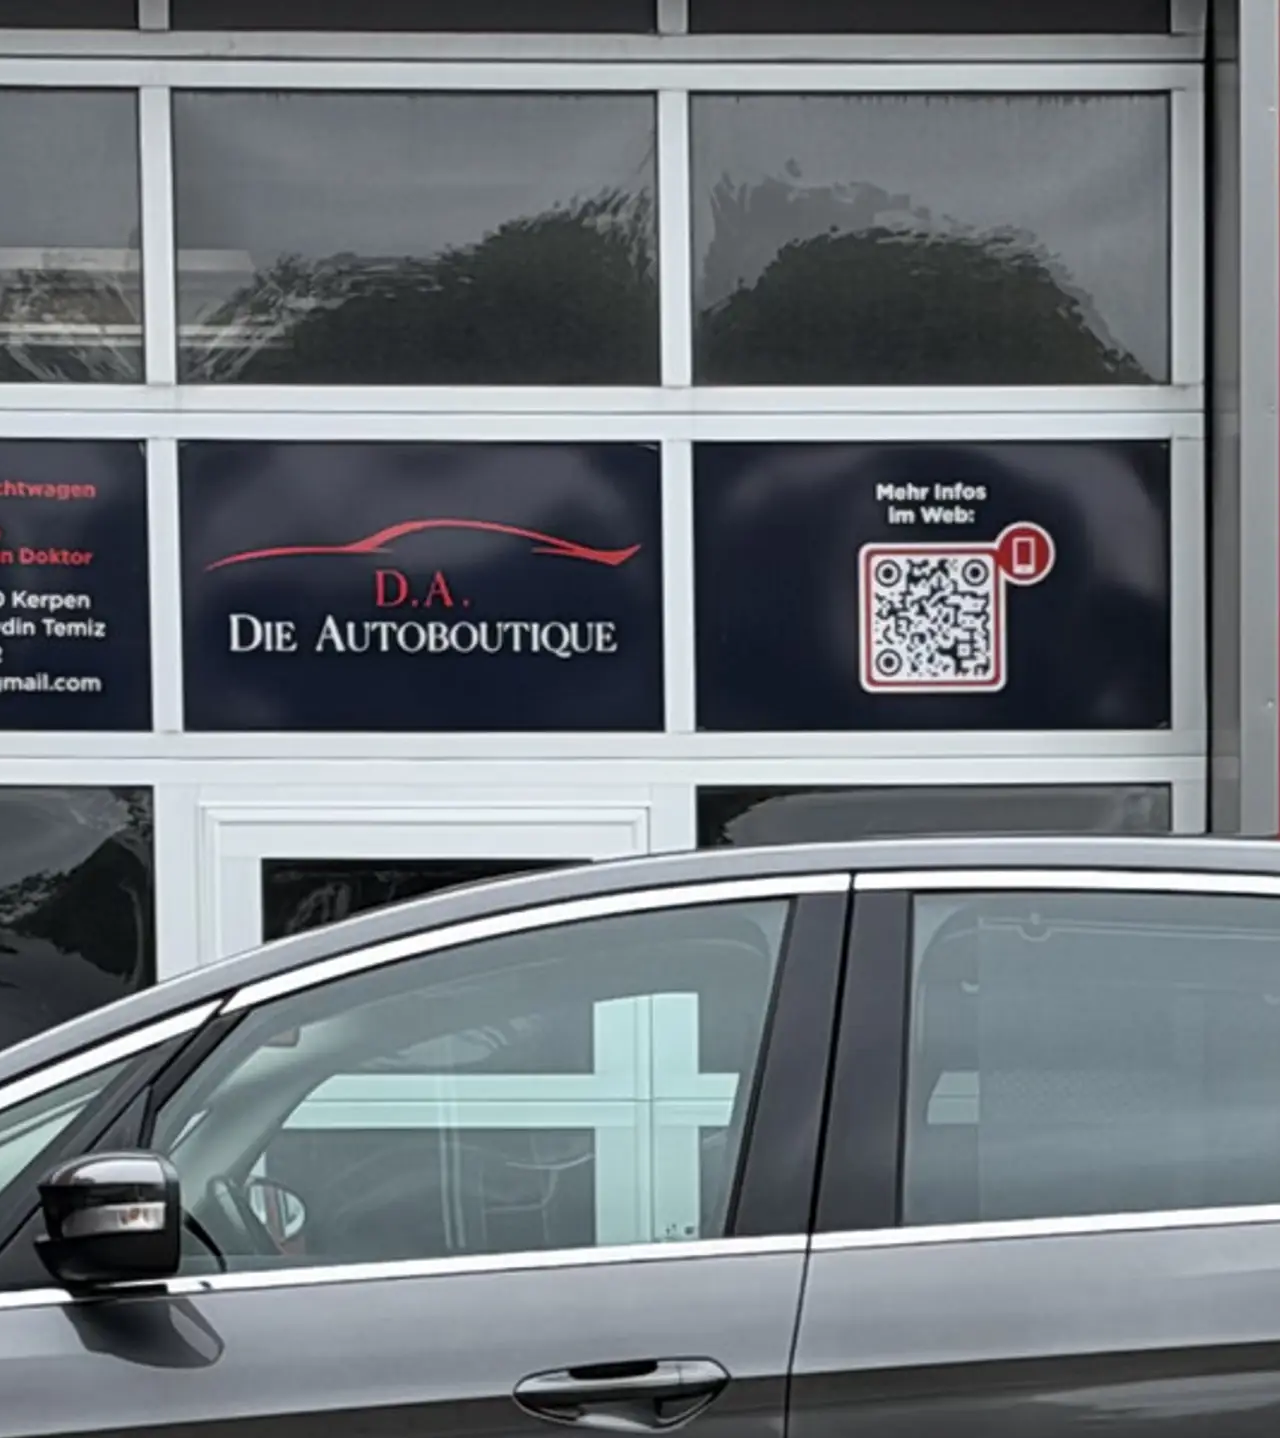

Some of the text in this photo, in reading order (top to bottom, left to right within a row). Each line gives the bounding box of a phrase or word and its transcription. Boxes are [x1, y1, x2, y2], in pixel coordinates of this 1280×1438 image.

[876, 483, 987, 501] Mehr Infos
[919, 505, 975, 524] Web:
[20, 547, 94, 565] Doktor
[12, 590, 91, 613] Kerpen
[42, 618, 106, 637] Temiz
